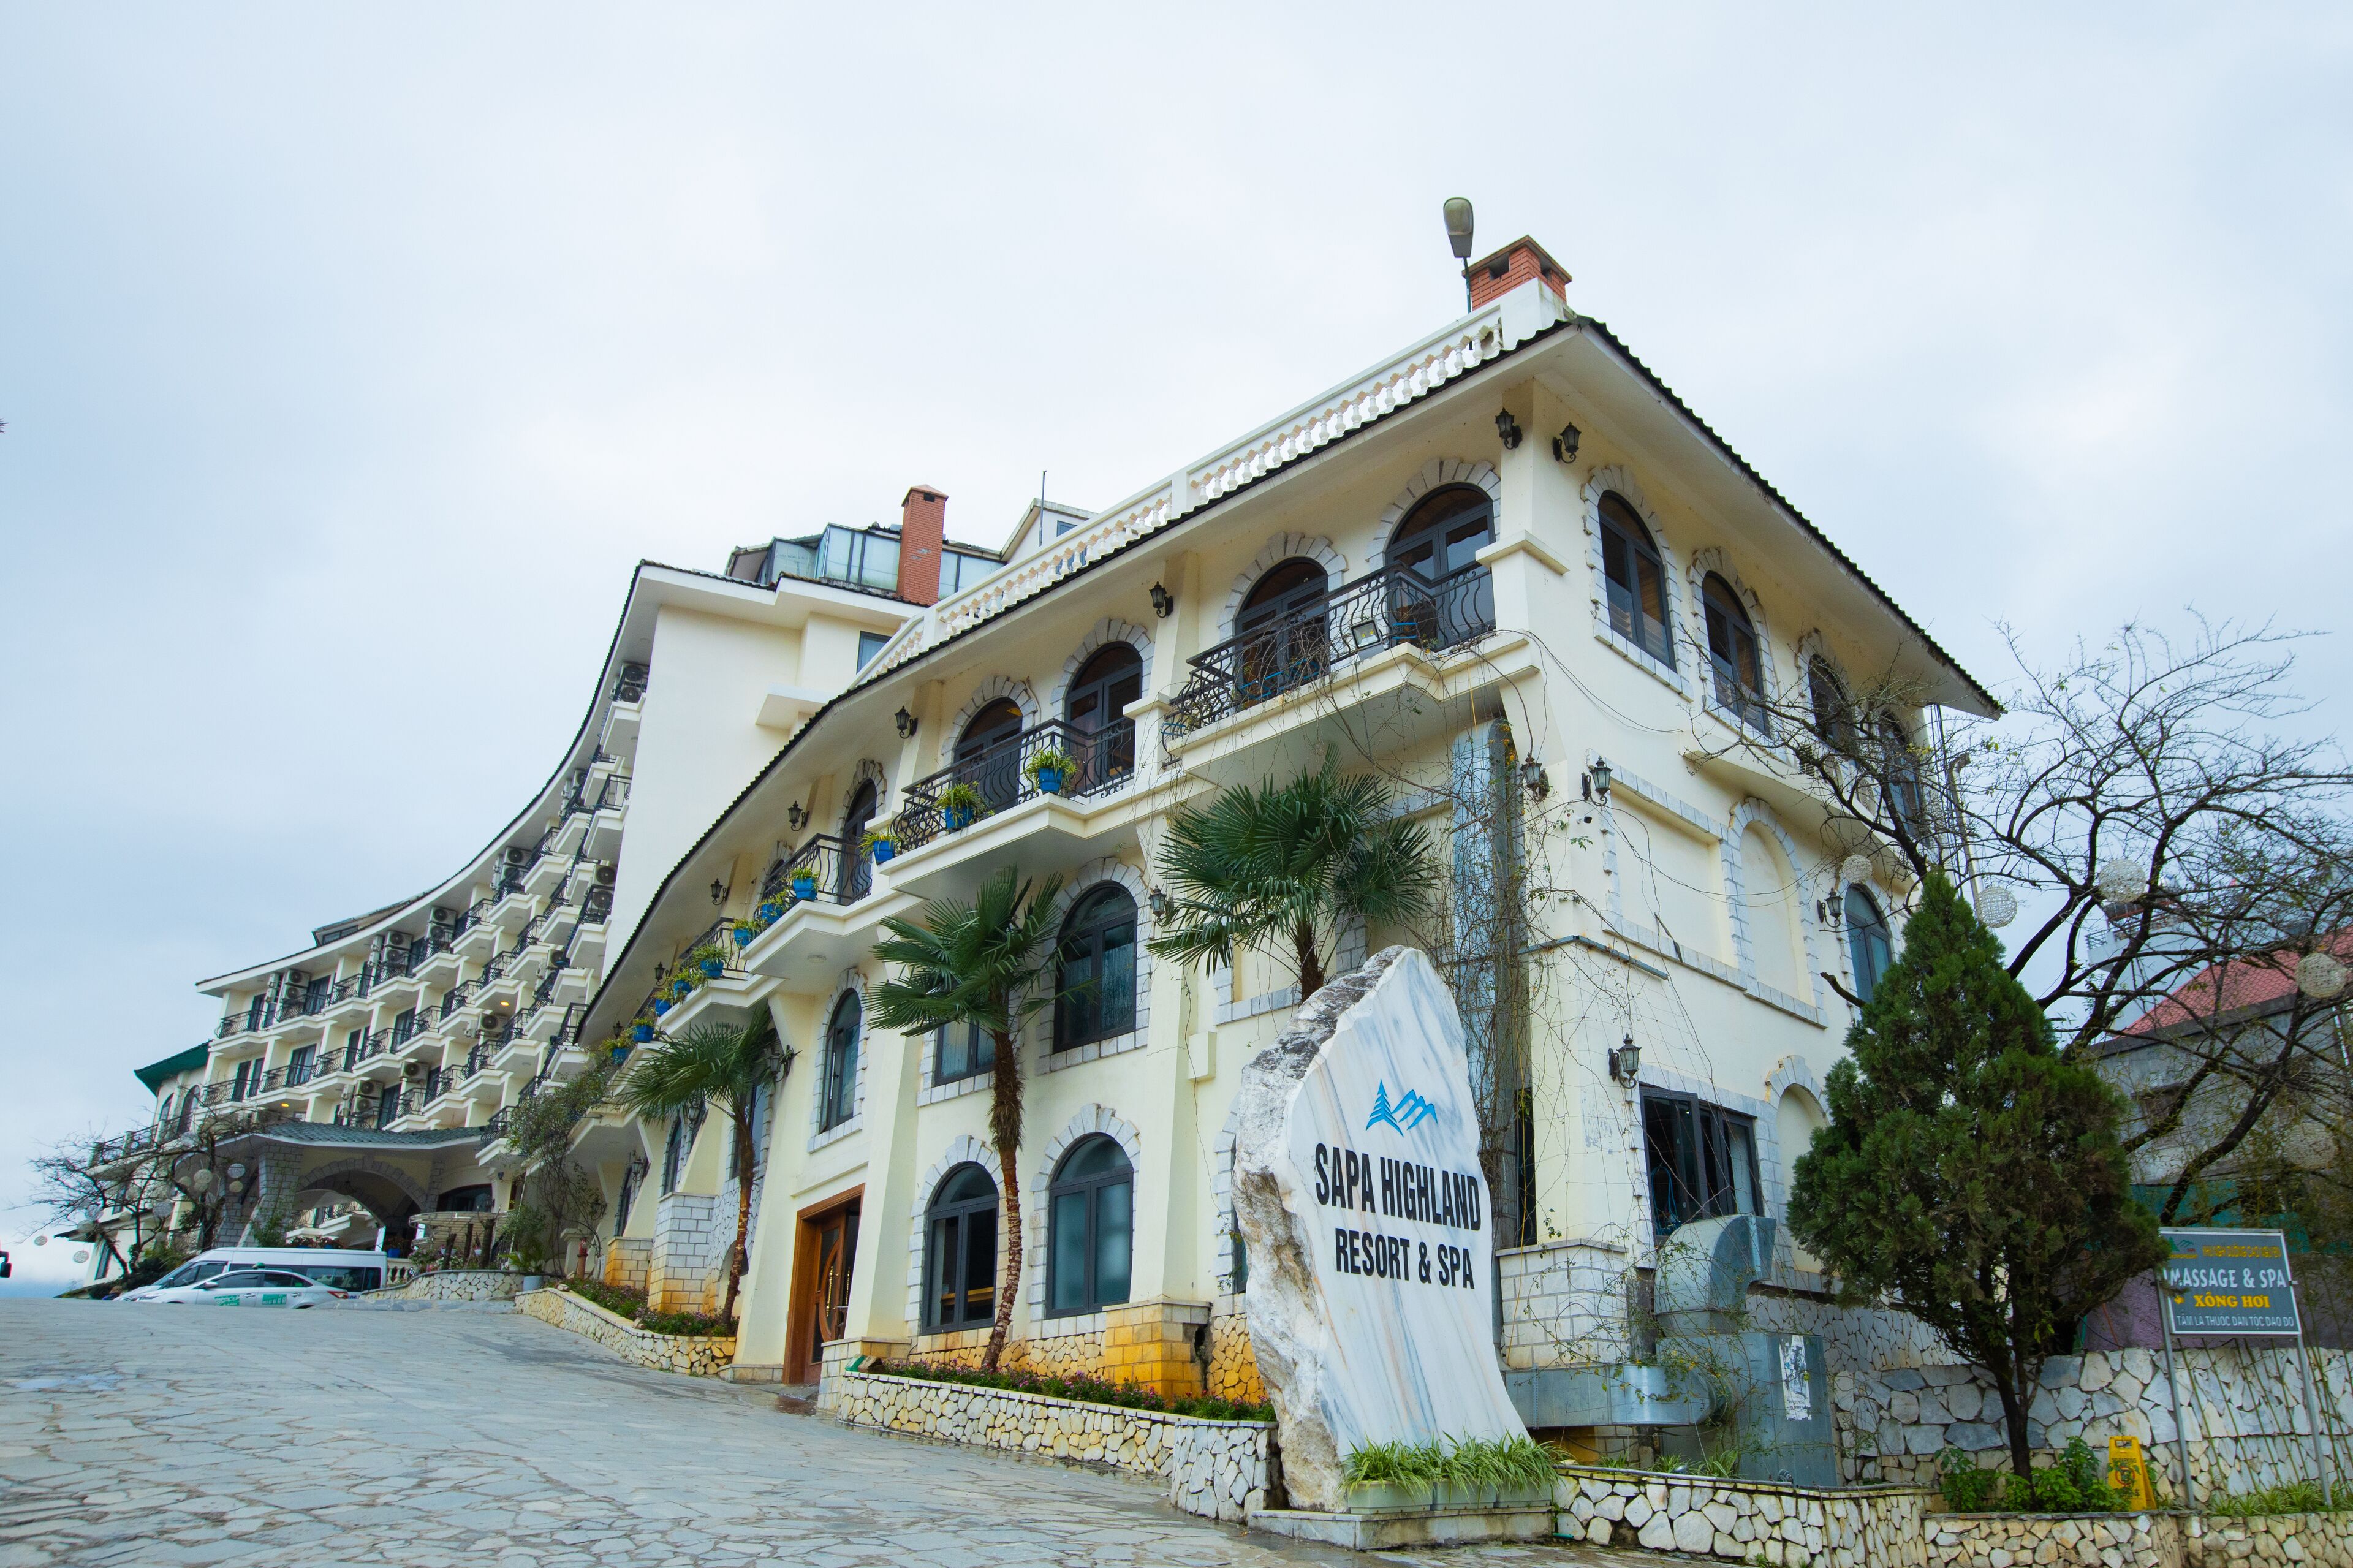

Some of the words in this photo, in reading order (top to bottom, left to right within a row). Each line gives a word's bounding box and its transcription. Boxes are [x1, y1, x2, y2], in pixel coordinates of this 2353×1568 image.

[1315, 1142, 1376, 1213] SAPA
[1380, 1156, 1482, 1231] HIGHLAND
[1335, 1227, 1410, 1281] RESORT
[1418, 1241, 1431, 1284] &
[1438, 1244, 1475, 1289] SPA
[2170, 1267, 2238, 1288] MASSAGE
[2243, 1268, 2255, 1288] &
[2259, 1268, 2287, 1288] SPA
[2193, 1291, 2238, 1308] XÔNG
[2241, 1294, 2271, 1308] HƠI
